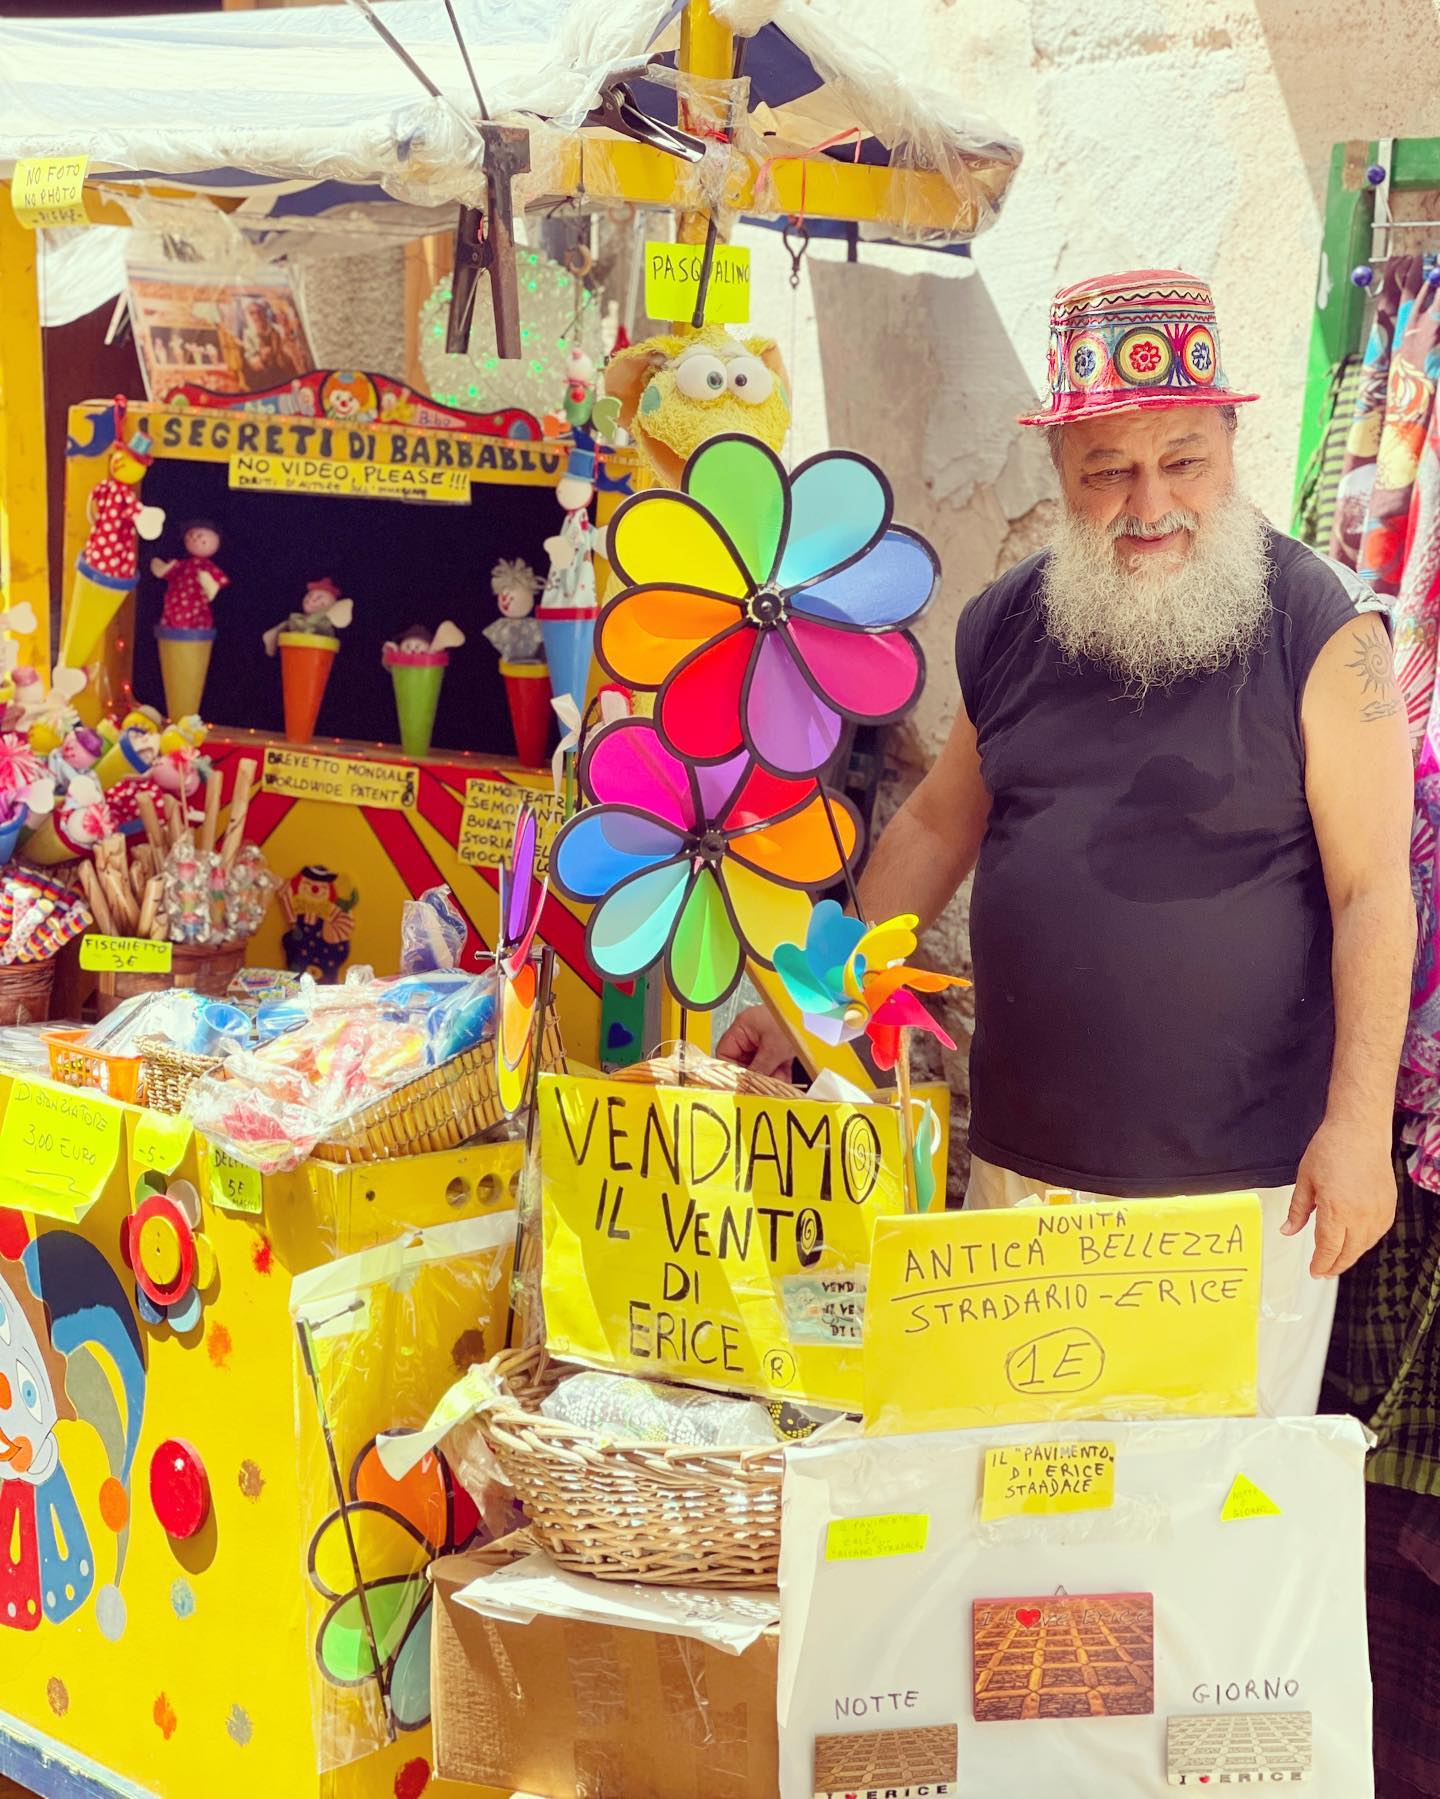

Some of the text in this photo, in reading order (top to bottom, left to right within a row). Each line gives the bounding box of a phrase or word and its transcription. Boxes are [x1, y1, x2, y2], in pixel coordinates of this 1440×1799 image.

[26, 164, 80, 187] NO FOTO
[41, 186, 76, 205] PHOTO
[653, 254, 750, 285] PASQALINO
[163, 417, 333, 457] SEGRETI
[348, 431, 376, 461] DI
[391, 434, 560, 474] BARBABLU
[238, 458, 270, 474] NO
[351, 783, 400, 803] PATENT
[470, 781, 566, 809] PRIMO TEATR
[85, 938, 167, 954] FISCHIETTO
[60, 1137, 96, 1166] EURO
[554, 1086, 882, 1205] VENDIAMO
[595, 1178, 825, 1268] IL VENTO
[905, 1223, 1244, 1283] ANTICA BELLEZZA
[662, 1261, 700, 1305] DI
[629, 1300, 744, 1373] ERICE
[992, 1451, 1008, 1467] IL
[1009, 1462, 1105, 1481] DI ERICE
[1005, 1478, 1093, 1499] STRADALE
[1192, 1677, 1299, 1705] GIORNO
[835, 1691, 919, 1720] NOTTE
[1220, 1772, 1302, 1783] ERICE
[867, 1785, 948, 1799] ERICE
